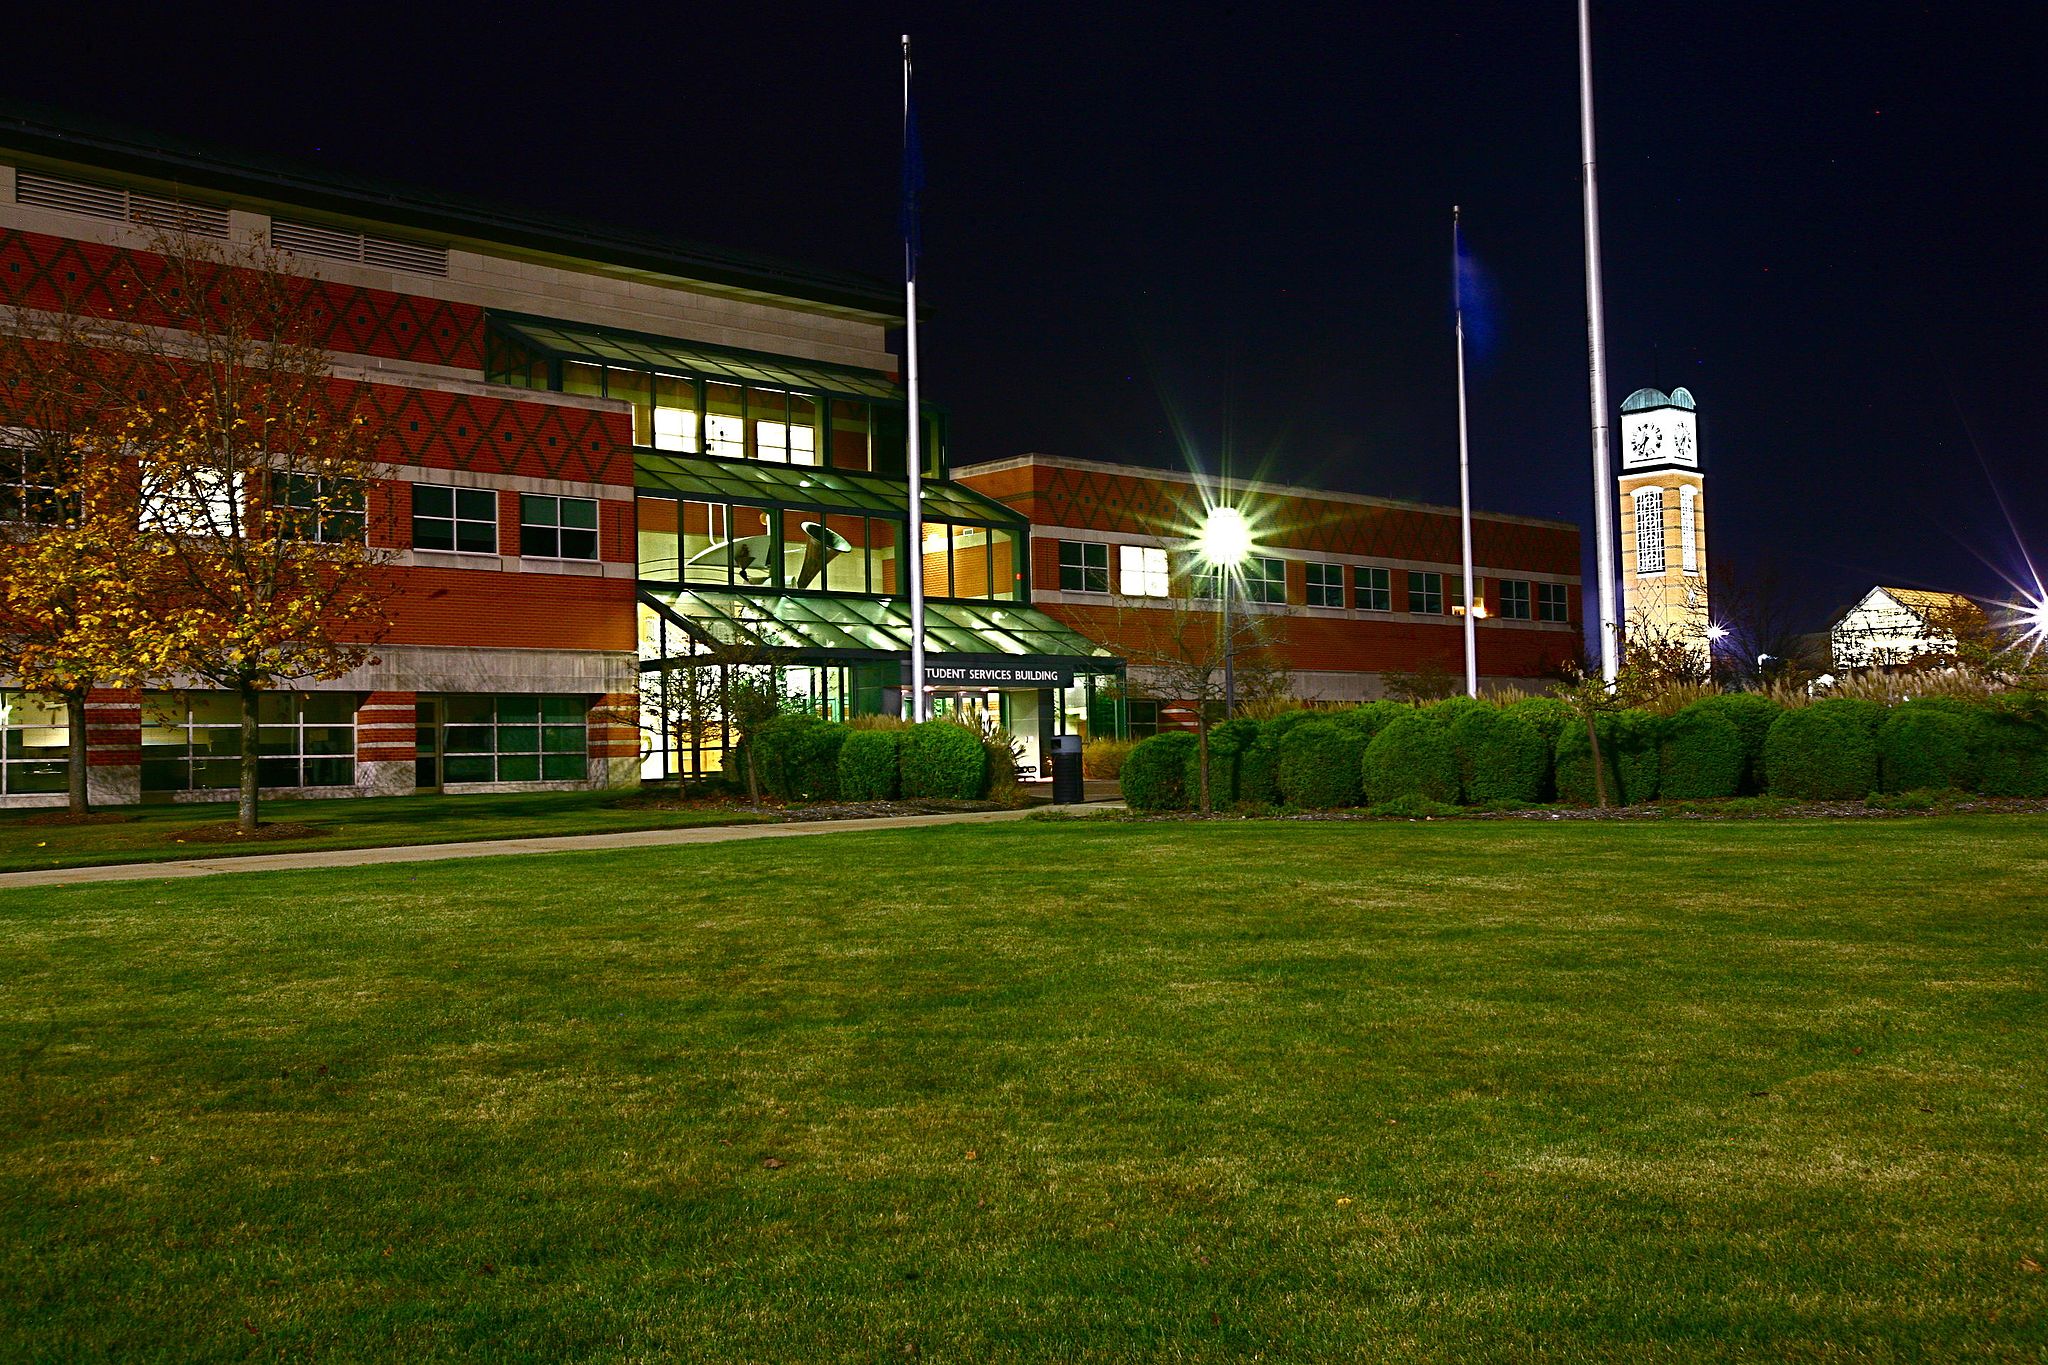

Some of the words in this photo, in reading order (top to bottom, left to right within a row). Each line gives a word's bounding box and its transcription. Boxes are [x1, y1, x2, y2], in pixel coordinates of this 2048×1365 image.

[924, 667, 966, 679] TUDENT
[969, 668, 1012, 680] SERVICES
[1015, 670, 1058, 681] BUILDING
